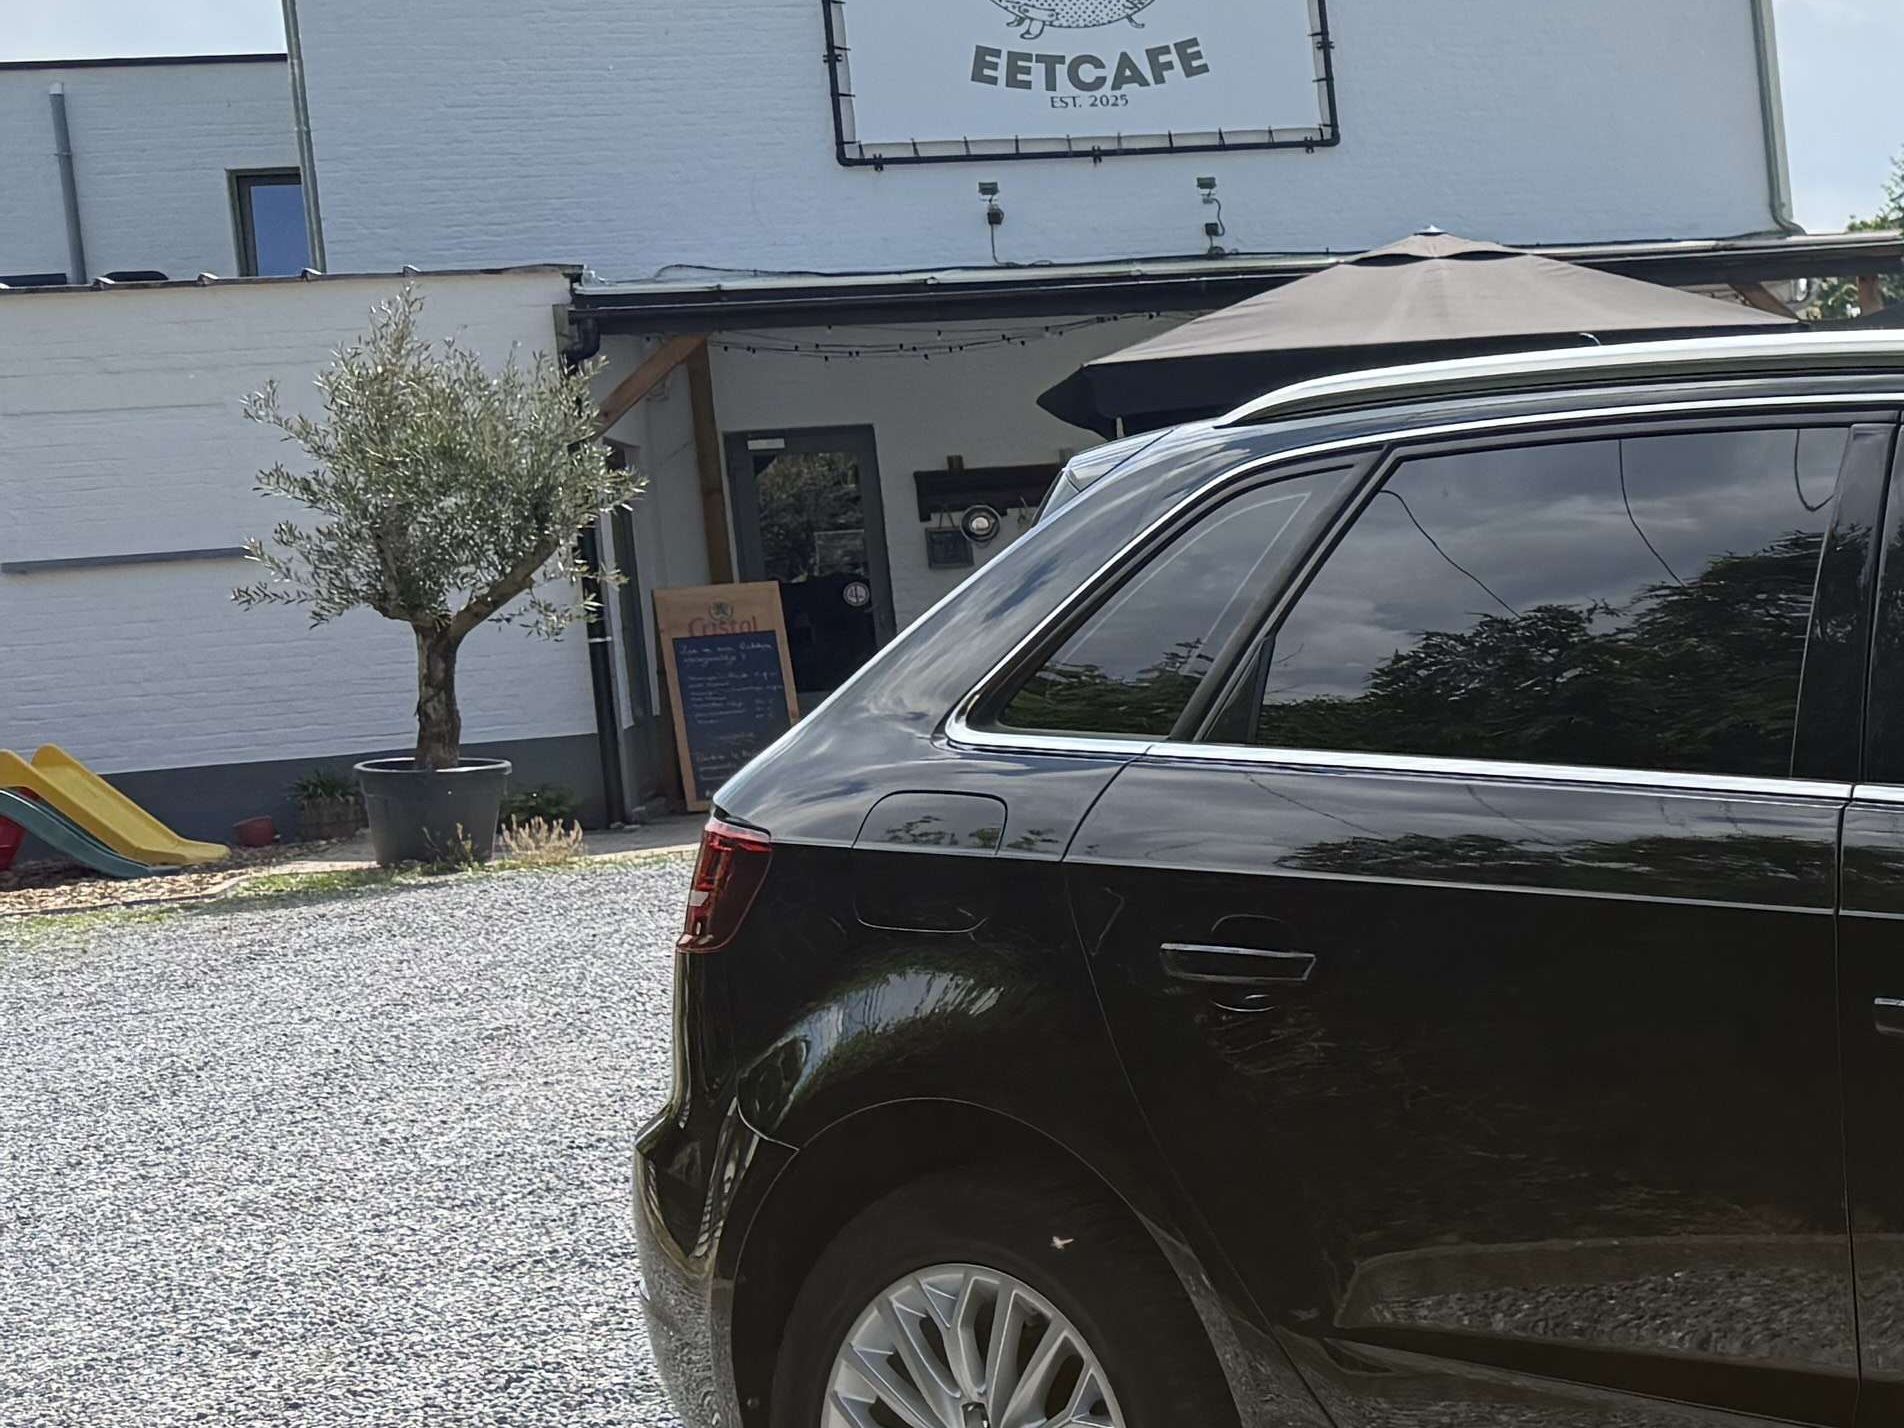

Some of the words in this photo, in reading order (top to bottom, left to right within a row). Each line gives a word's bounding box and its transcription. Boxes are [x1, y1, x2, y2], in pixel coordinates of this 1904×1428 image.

[970, 37, 1210, 93] EETCAFE
[1050, 95, 1082, 109] EST.
[1088, 94, 1129, 107] 2025
